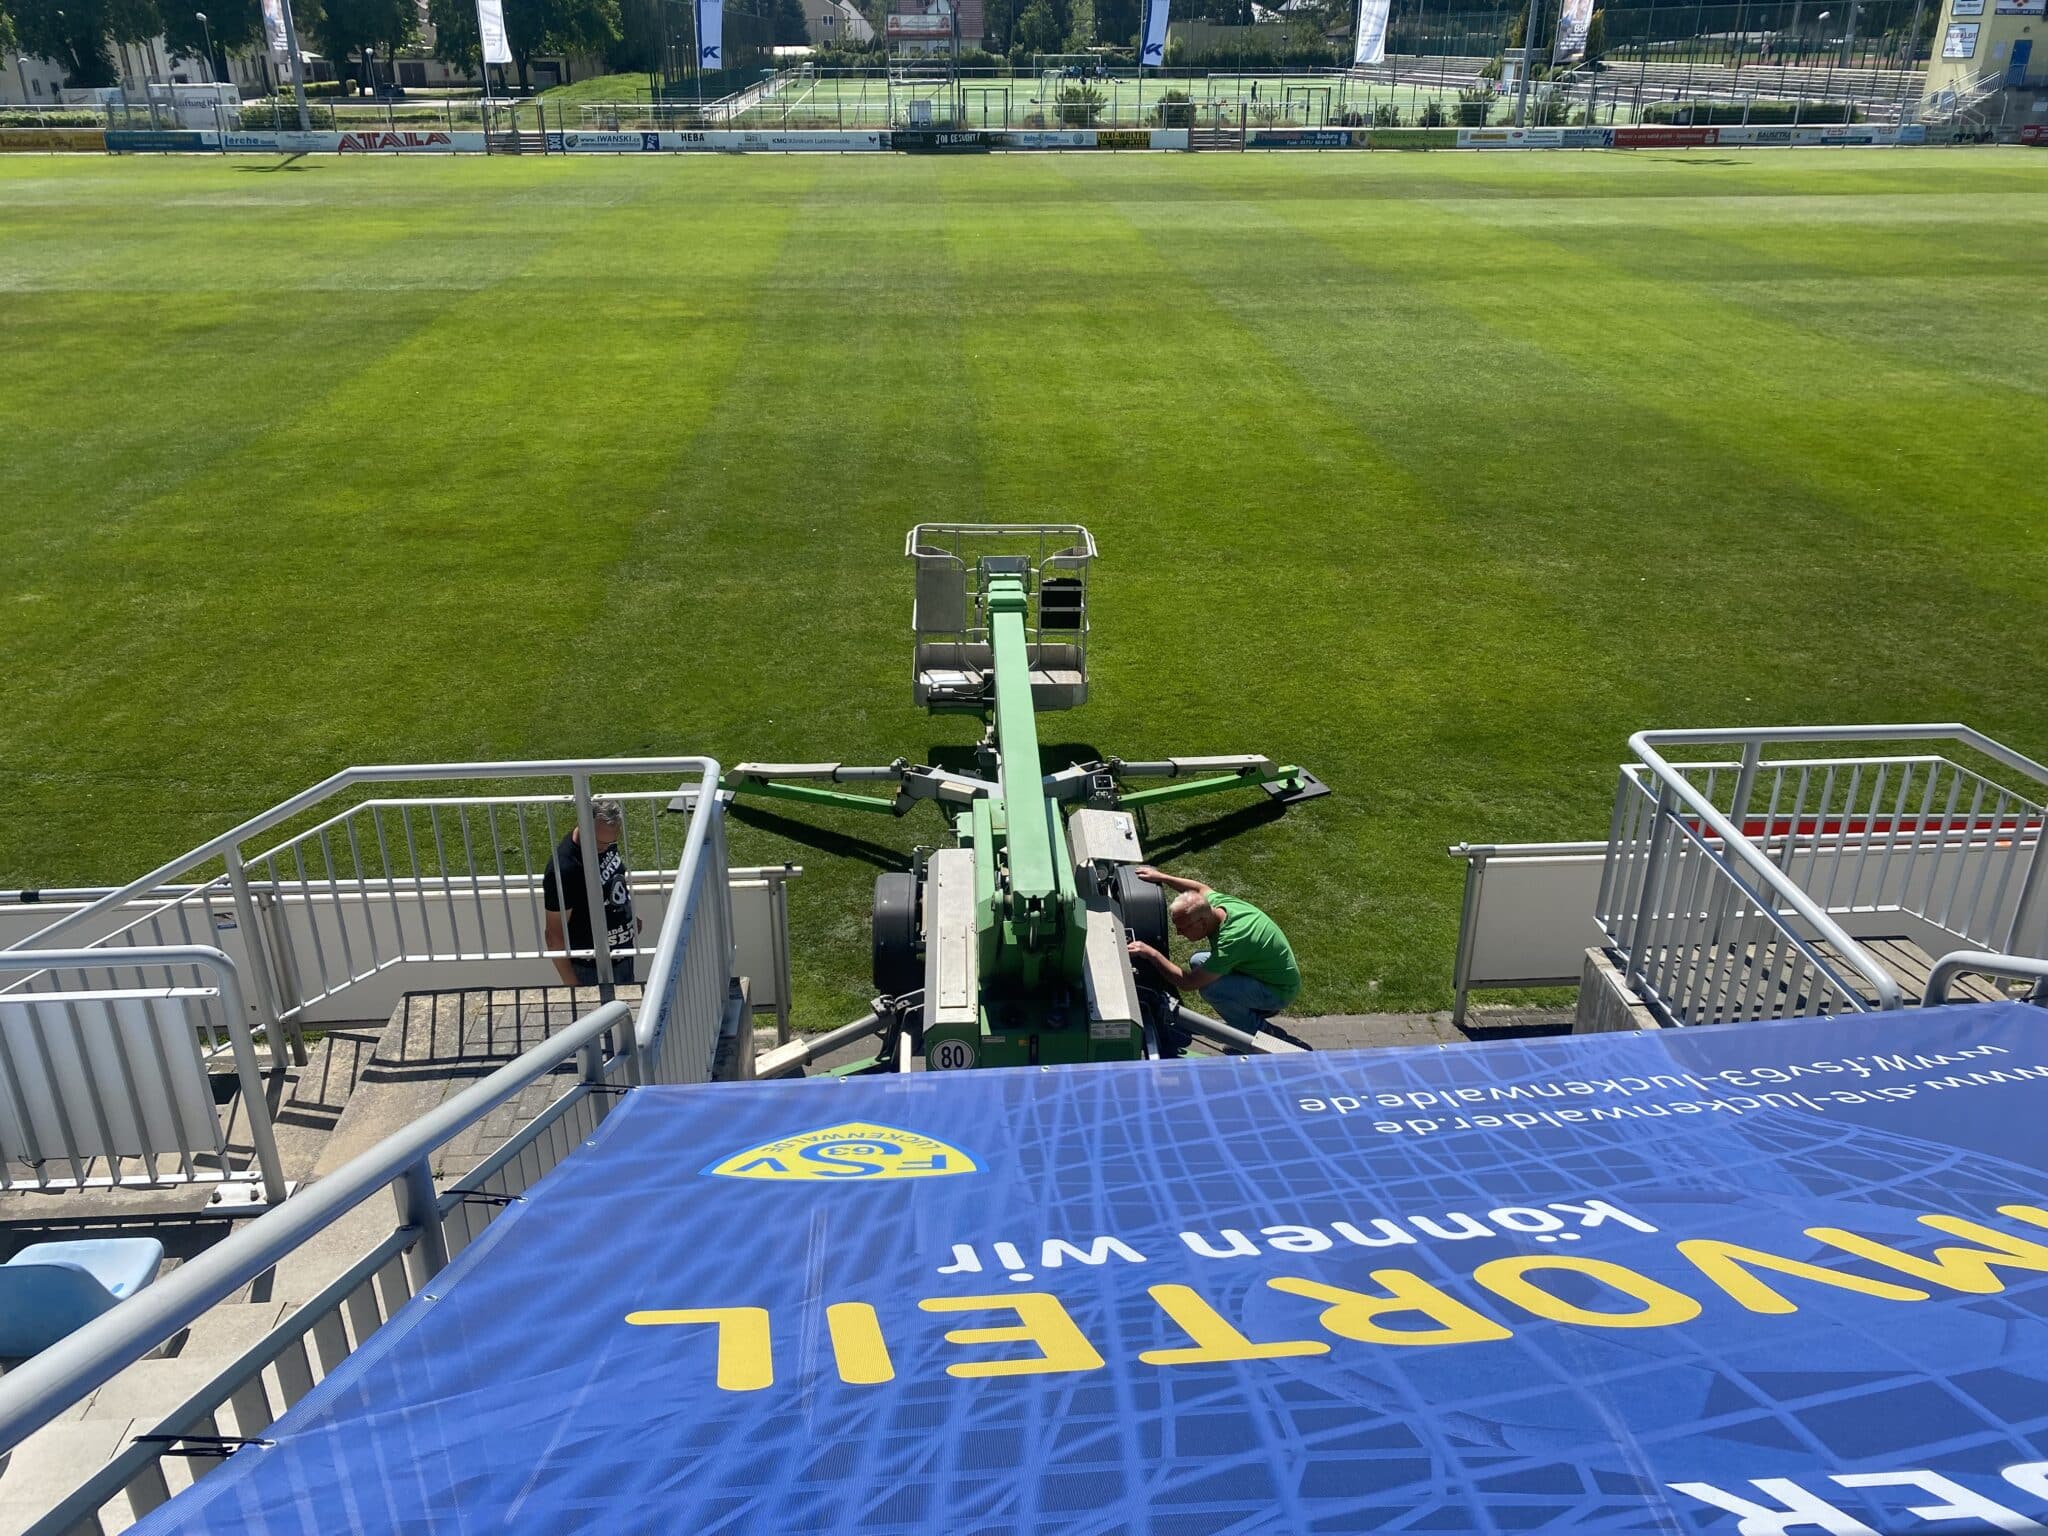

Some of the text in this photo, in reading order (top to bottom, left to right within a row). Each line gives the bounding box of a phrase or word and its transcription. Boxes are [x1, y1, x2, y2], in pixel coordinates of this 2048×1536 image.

[337, 132, 452, 151] ATALA
[681, 133, 705, 142] HEBA
[941, 1045, 964, 1069] 80
[1299, 1044, 2010, 1114] www.fsv63-luckenwalde.de
[1373, 1065, 2048, 1137] www.die-luckenwalder.de
[760, 1132, 941, 1153] LUCKENWALDE
[827, 1146, 882, 1156] 63
[937, 1200, 1660, 1282] können wir
